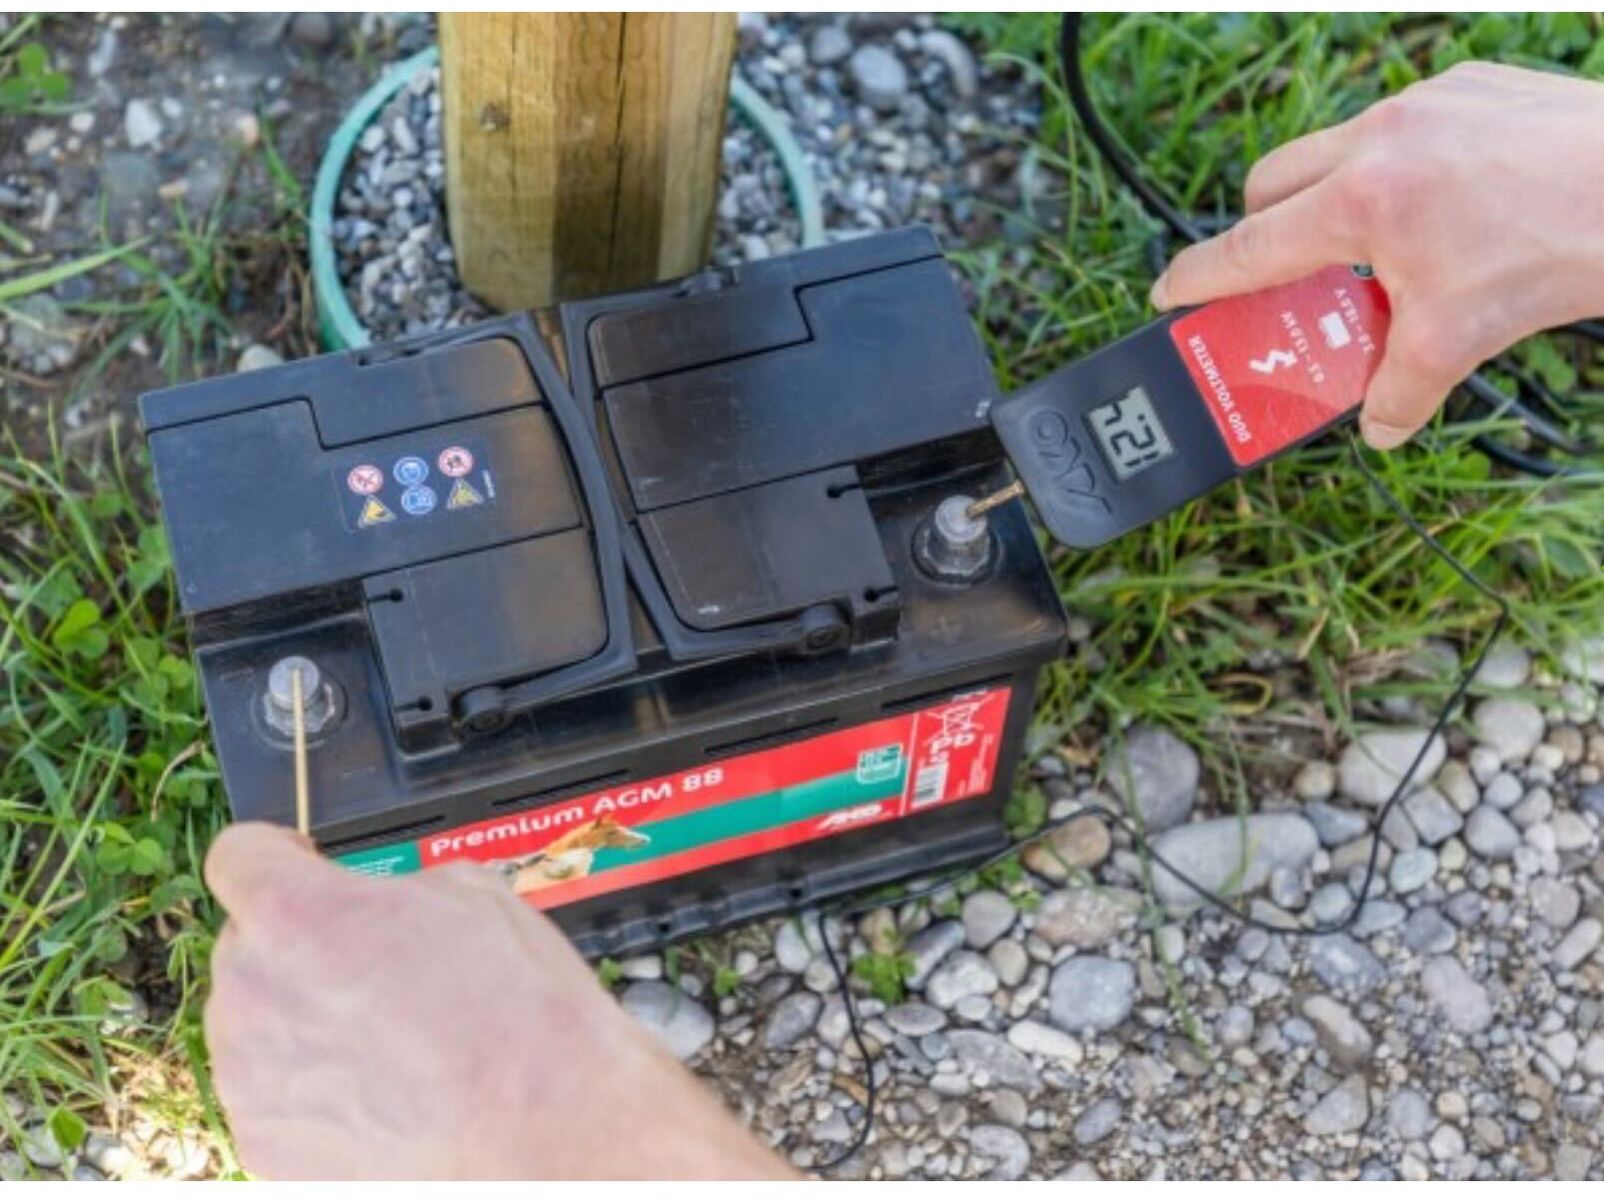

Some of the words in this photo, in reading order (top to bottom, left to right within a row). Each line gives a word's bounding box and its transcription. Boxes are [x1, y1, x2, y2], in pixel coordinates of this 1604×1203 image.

[1188, 335, 1235, 411] VOLTMETER
[1228, 411, 1252, 443] DUO
[430, 805, 584, 857] Premium
[592, 782, 673, 814] AGM
[682, 767, 724, 792] 88
